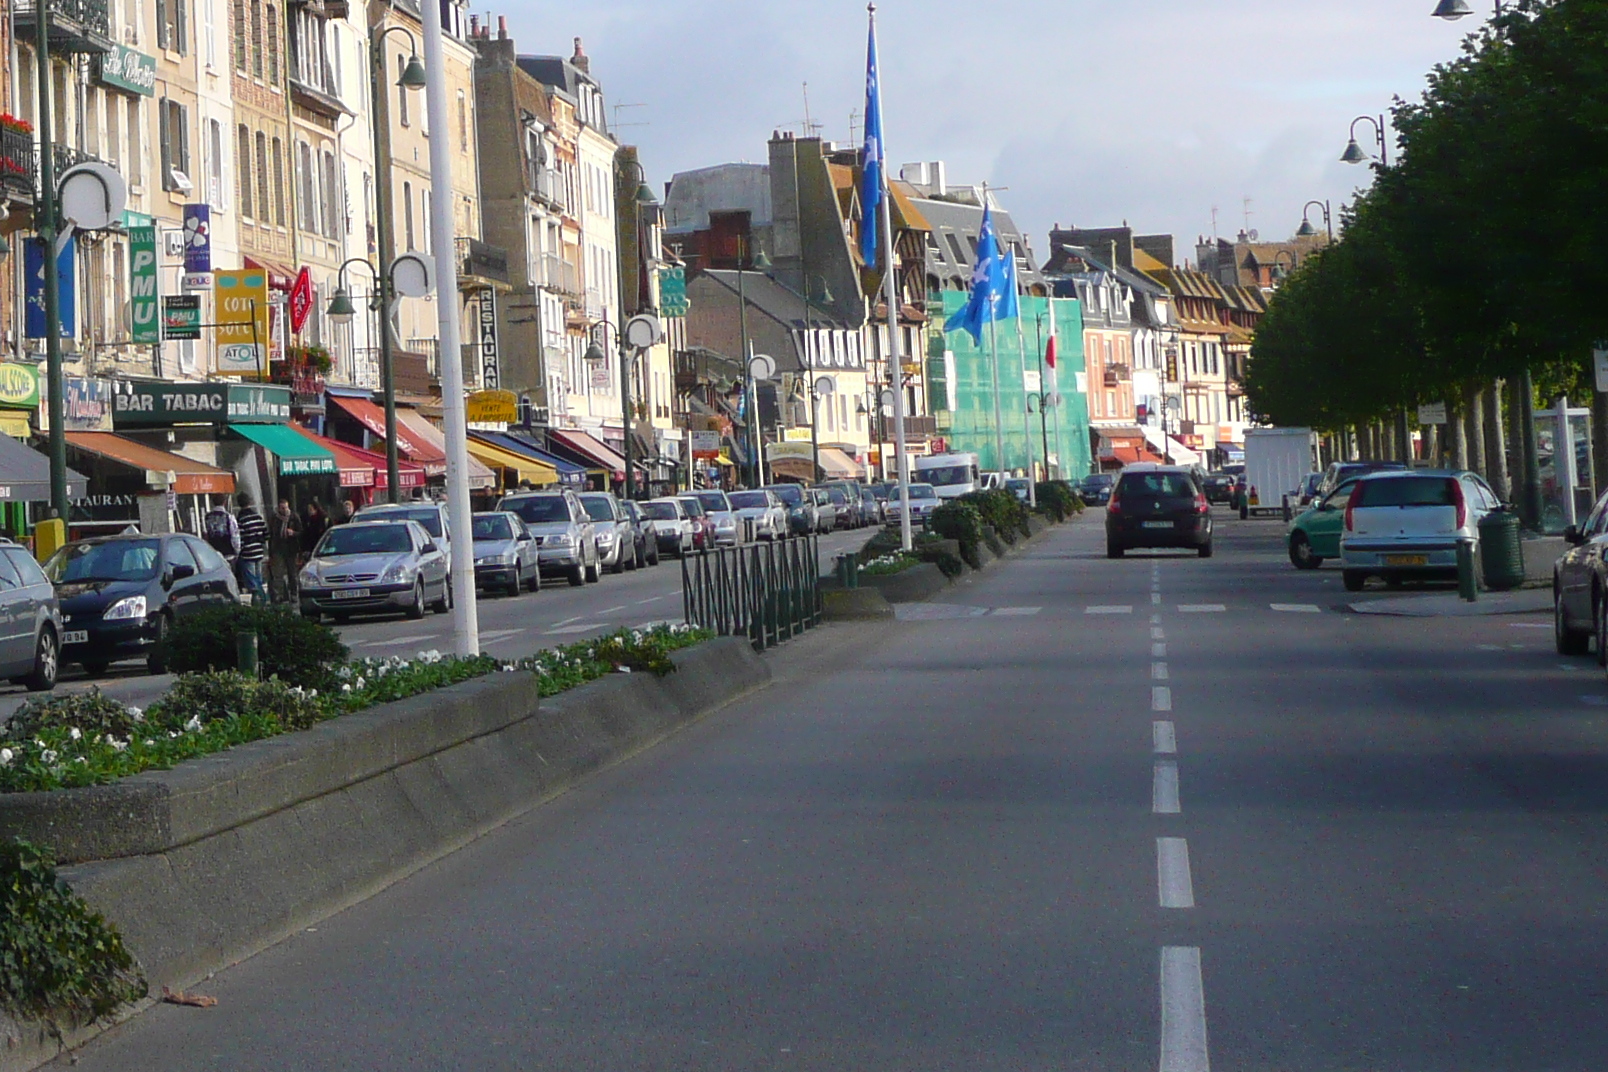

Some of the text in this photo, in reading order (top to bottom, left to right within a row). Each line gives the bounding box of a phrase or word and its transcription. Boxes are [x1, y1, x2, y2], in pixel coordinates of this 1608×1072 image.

[130, 231, 155, 243] BAR
[132, 250, 154, 324] PMU
[225, 345, 257, 360] ATOL
[116, 394, 154, 413] BAR
[162, 392, 223, 411] TABAC
